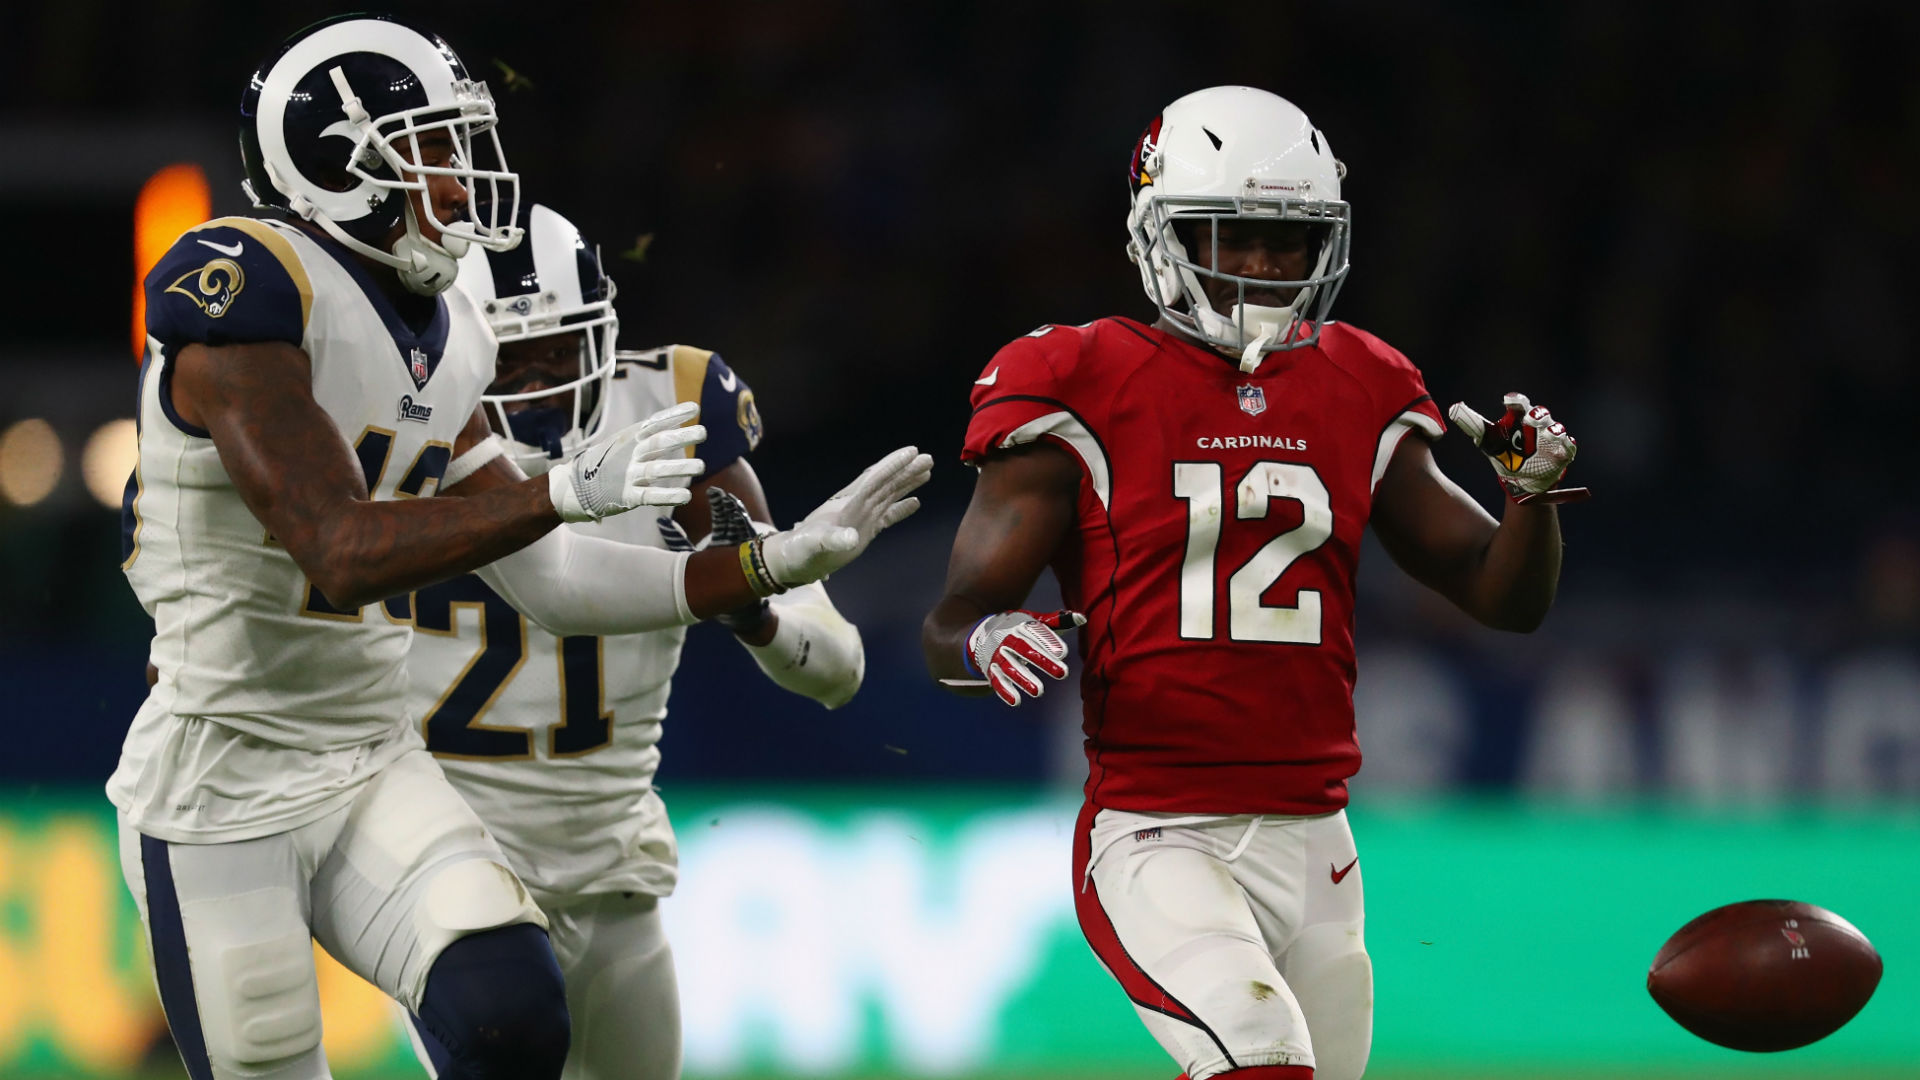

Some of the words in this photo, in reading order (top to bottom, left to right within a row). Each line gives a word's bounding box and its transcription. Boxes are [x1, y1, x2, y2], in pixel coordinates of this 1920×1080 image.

[399, 394, 433, 421] Rams
[1196, 435, 1307, 451] CARDINALS
[1172, 460, 1334, 646] 12
[409, 569, 614, 763] 21
